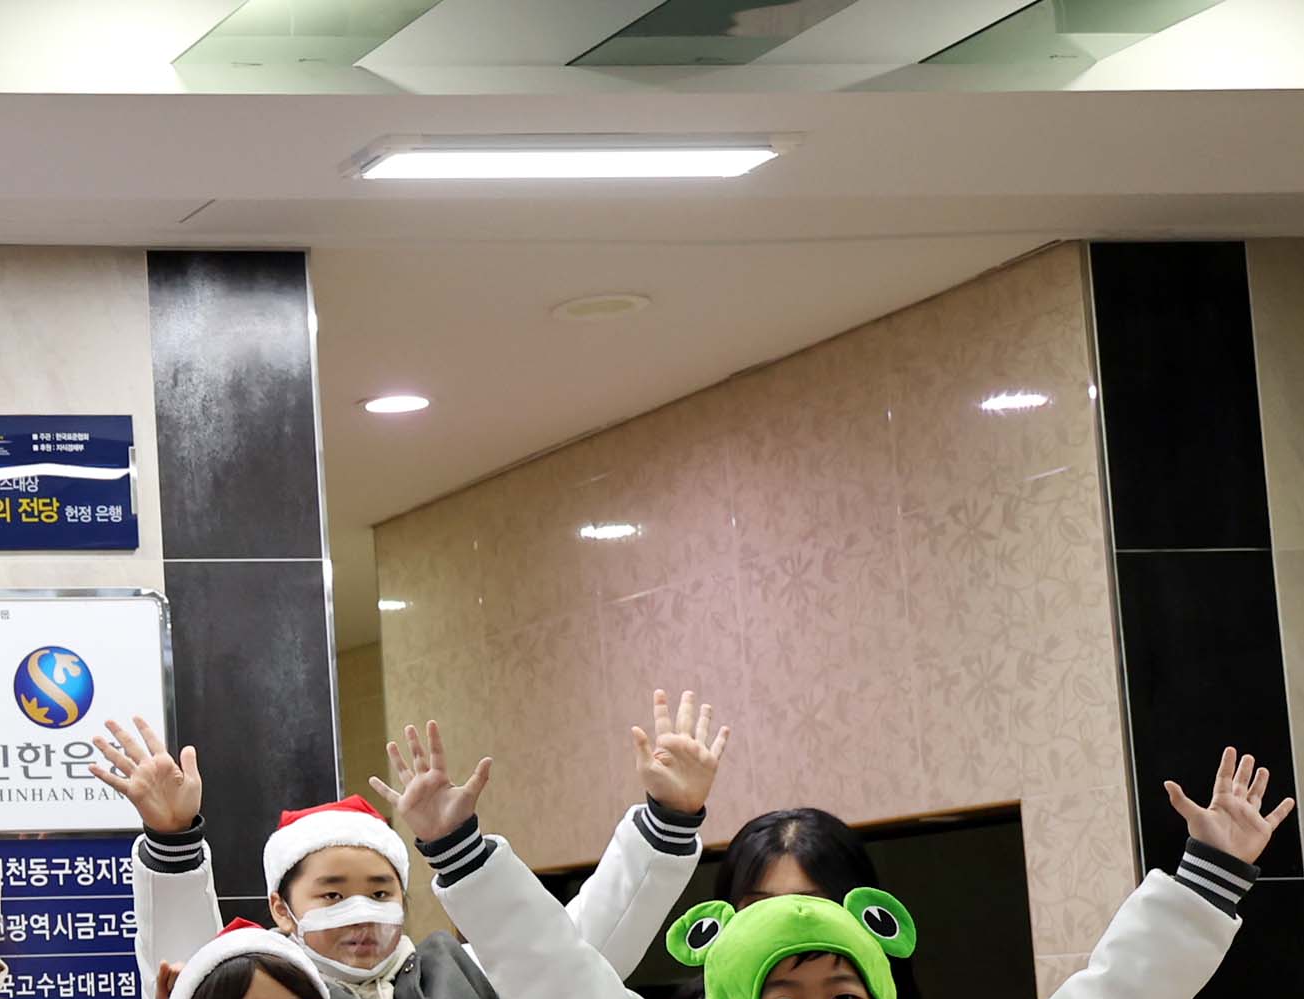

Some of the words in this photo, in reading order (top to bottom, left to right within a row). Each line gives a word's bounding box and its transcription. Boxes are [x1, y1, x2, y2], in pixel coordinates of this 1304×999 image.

[17, 496, 60, 523] 전당
[64, 504, 92, 523] 헌정
[95, 504, 123, 523] 은행
[84, 787, 126, 801] BAN
